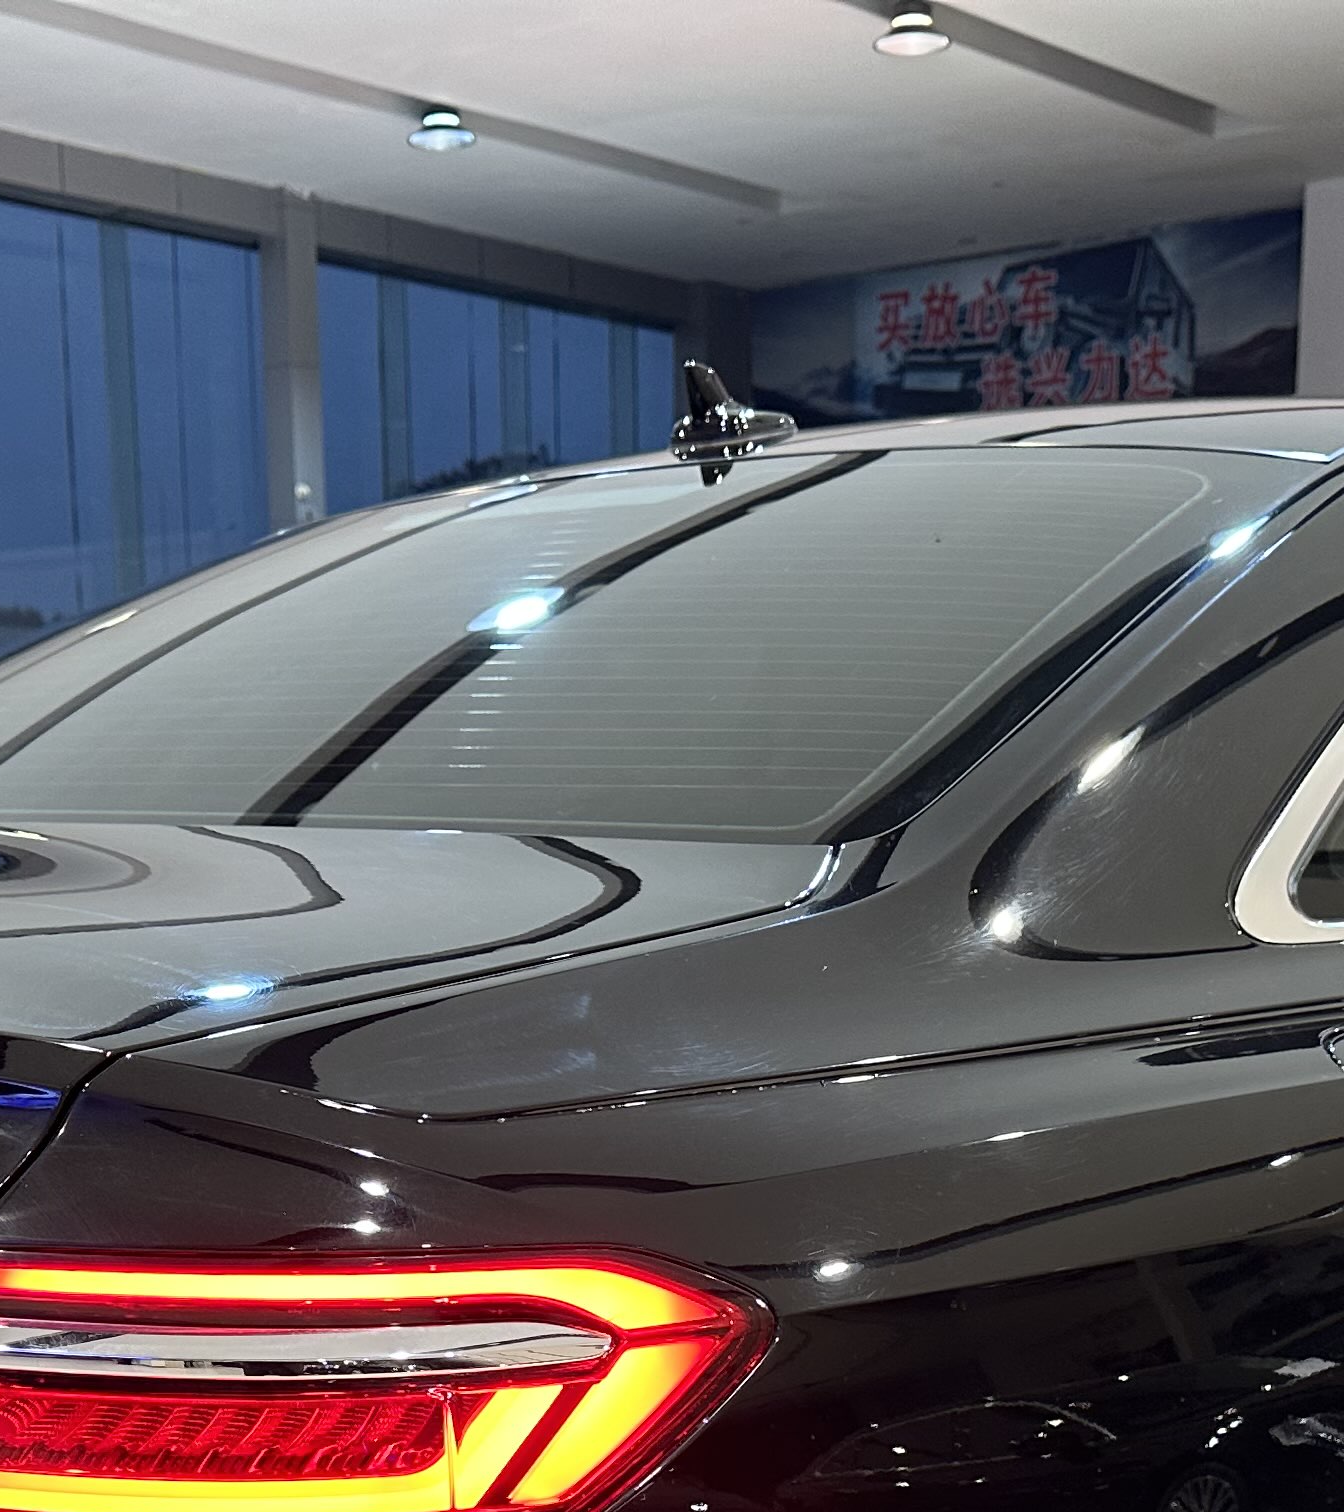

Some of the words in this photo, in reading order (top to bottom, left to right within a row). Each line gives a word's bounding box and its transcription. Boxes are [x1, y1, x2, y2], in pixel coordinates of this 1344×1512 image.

[874, 266, 1059, 352] 买放心车
[977, 336, 1176, 412] 选兴力达
